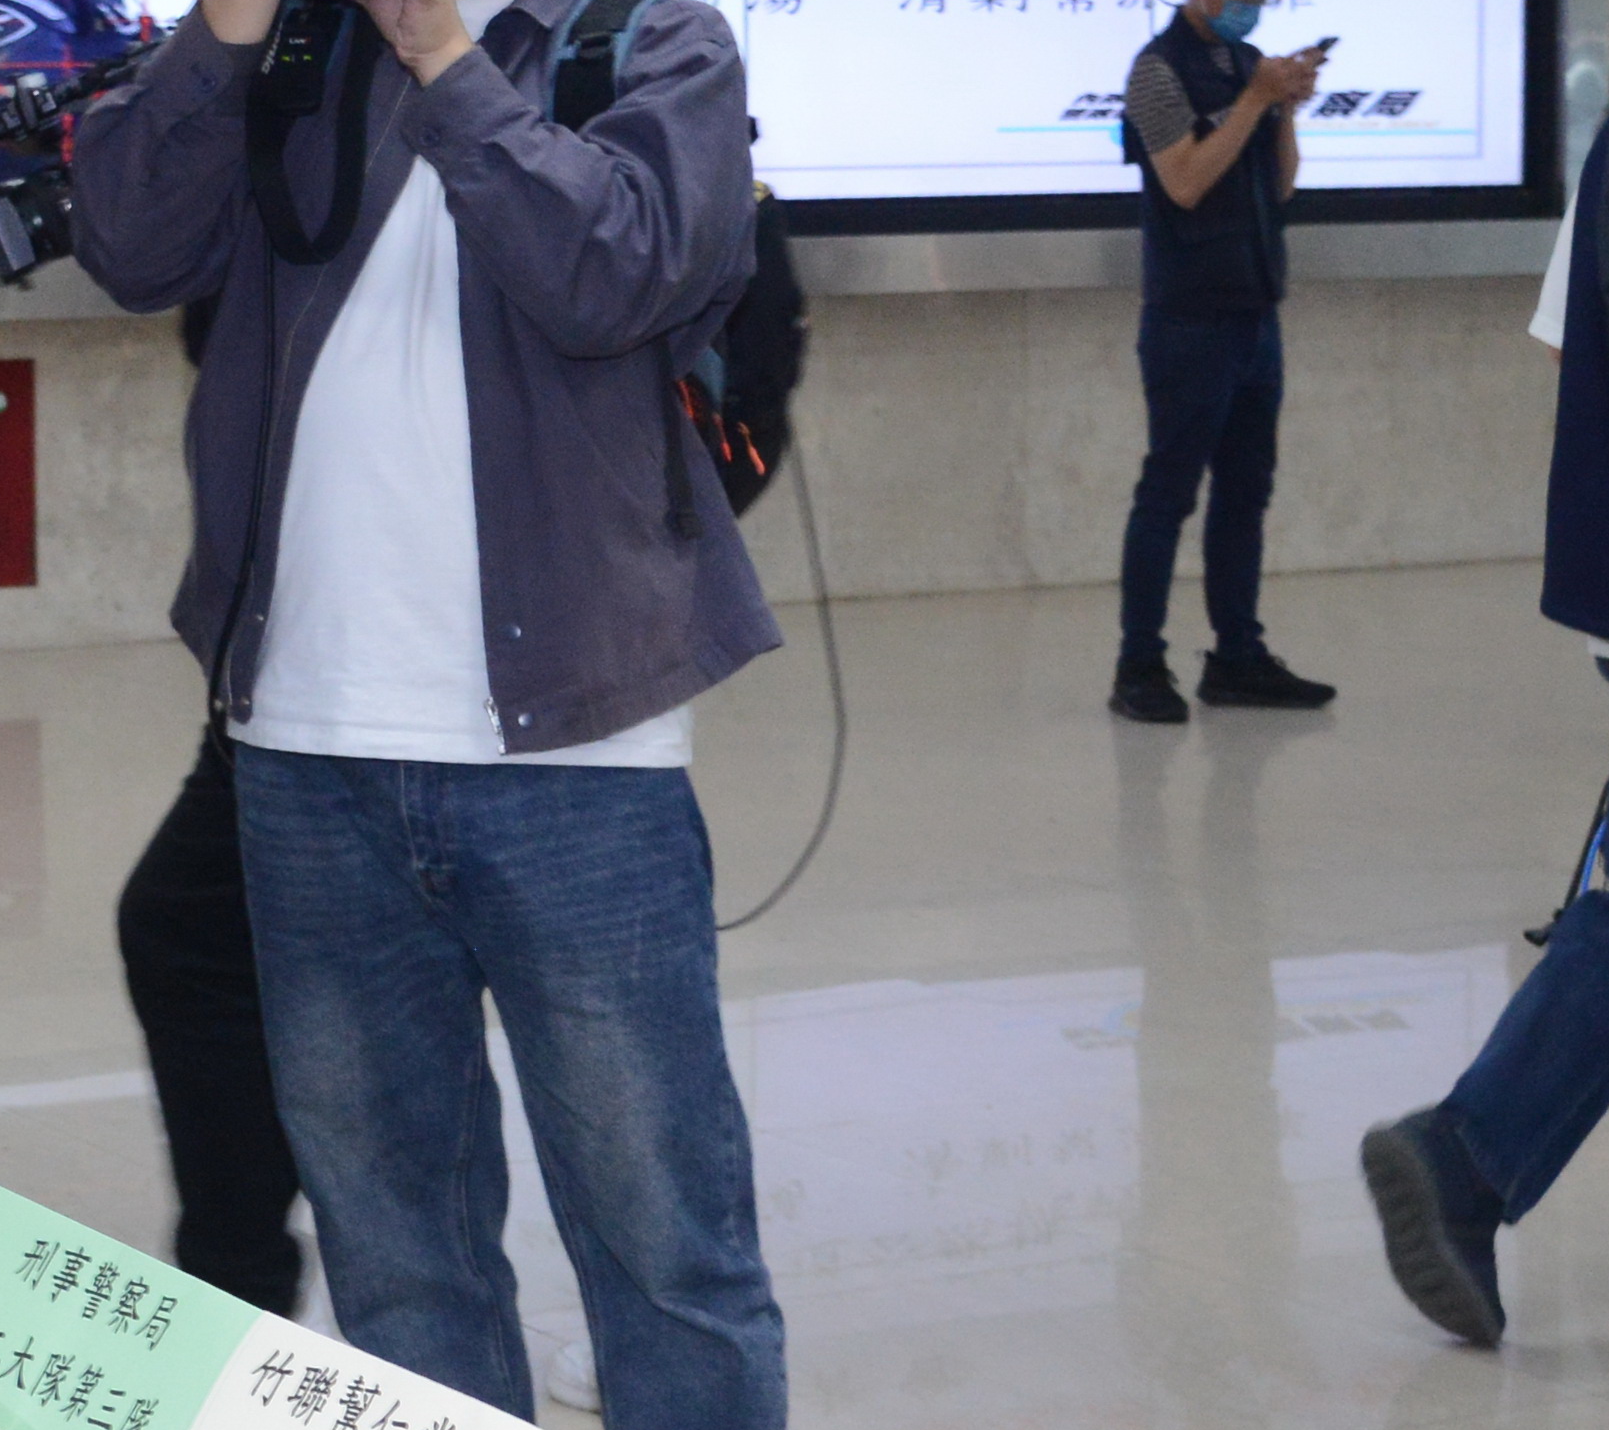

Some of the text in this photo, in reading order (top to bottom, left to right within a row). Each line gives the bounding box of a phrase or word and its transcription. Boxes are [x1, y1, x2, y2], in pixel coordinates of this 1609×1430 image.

[18, 1235, 182, 1353] 刑事警察局
